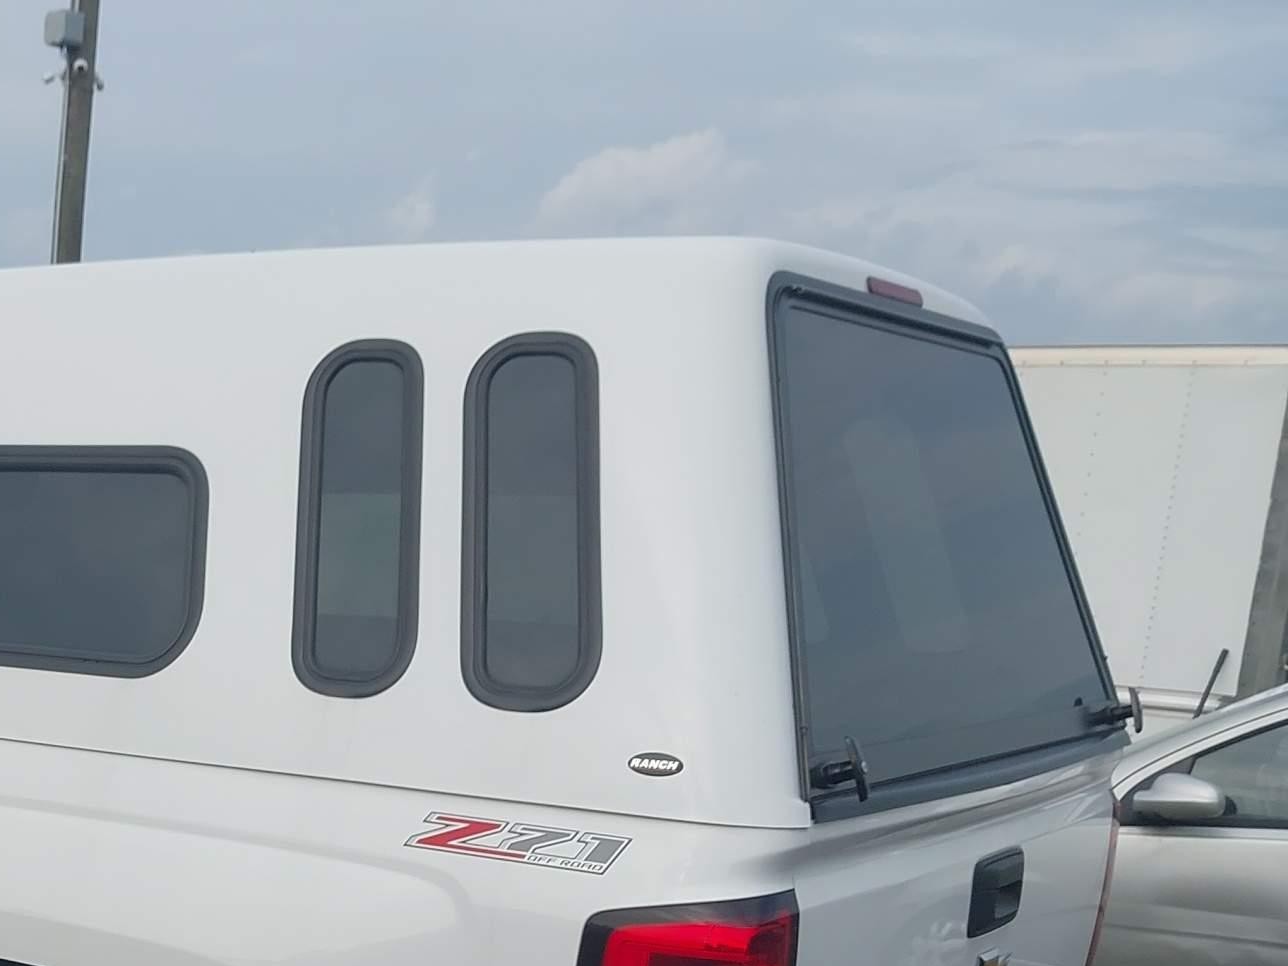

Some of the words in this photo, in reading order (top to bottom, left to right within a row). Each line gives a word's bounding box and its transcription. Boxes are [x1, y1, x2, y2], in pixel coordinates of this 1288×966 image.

[628, 757, 679, 771] RANCH
[404, 811, 633, 874] Z71
[559, 859, 604, 871] ROAD
